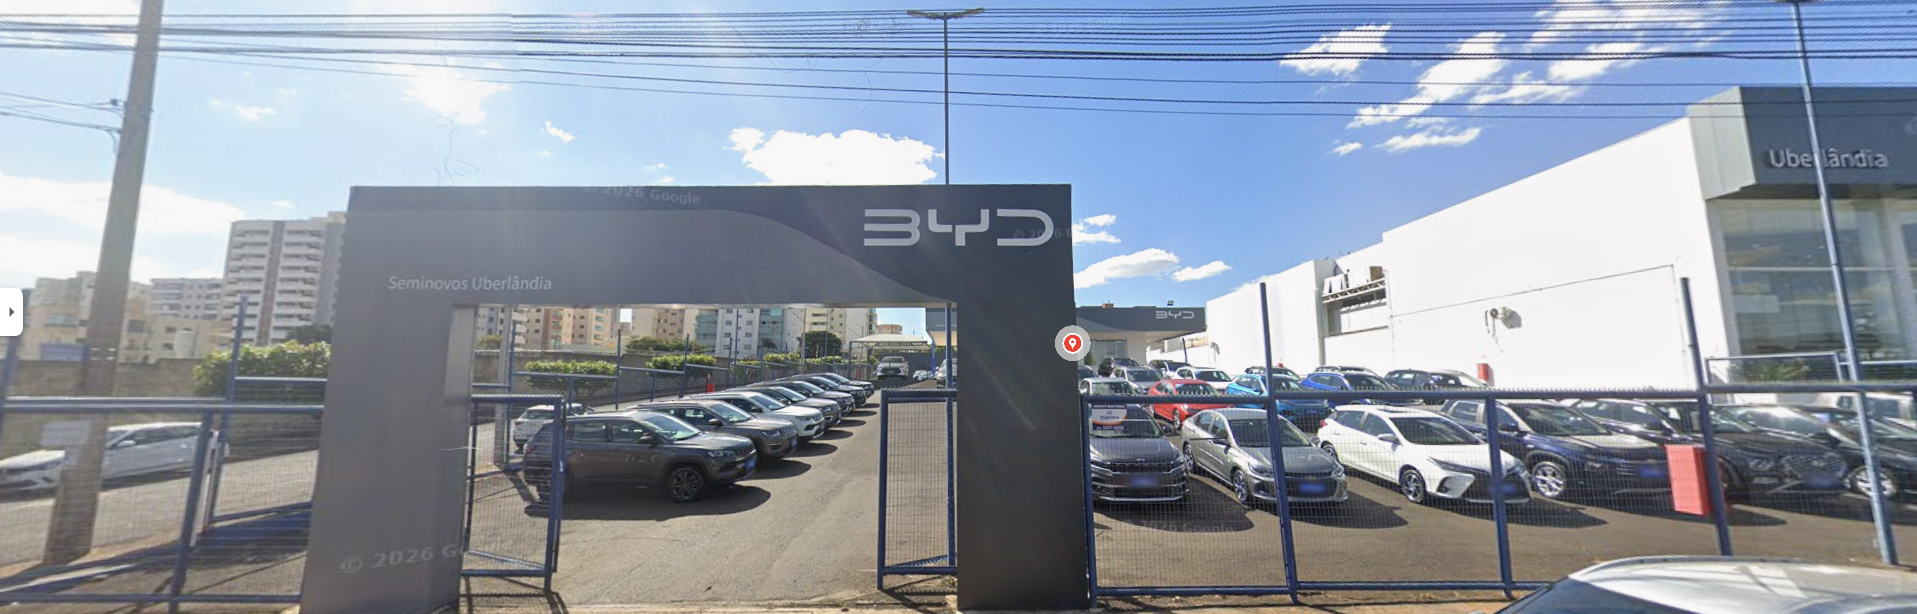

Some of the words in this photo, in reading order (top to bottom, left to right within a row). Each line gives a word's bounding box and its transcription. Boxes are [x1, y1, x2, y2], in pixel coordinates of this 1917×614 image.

[1768, 147, 1889, 168] Ubelândia
[864, 208, 1054, 246] BYD
[388, 276, 469, 290] Seminovos
[472, 276, 552, 290] Uberlândia
[1155, 310, 1195, 319] BYD
